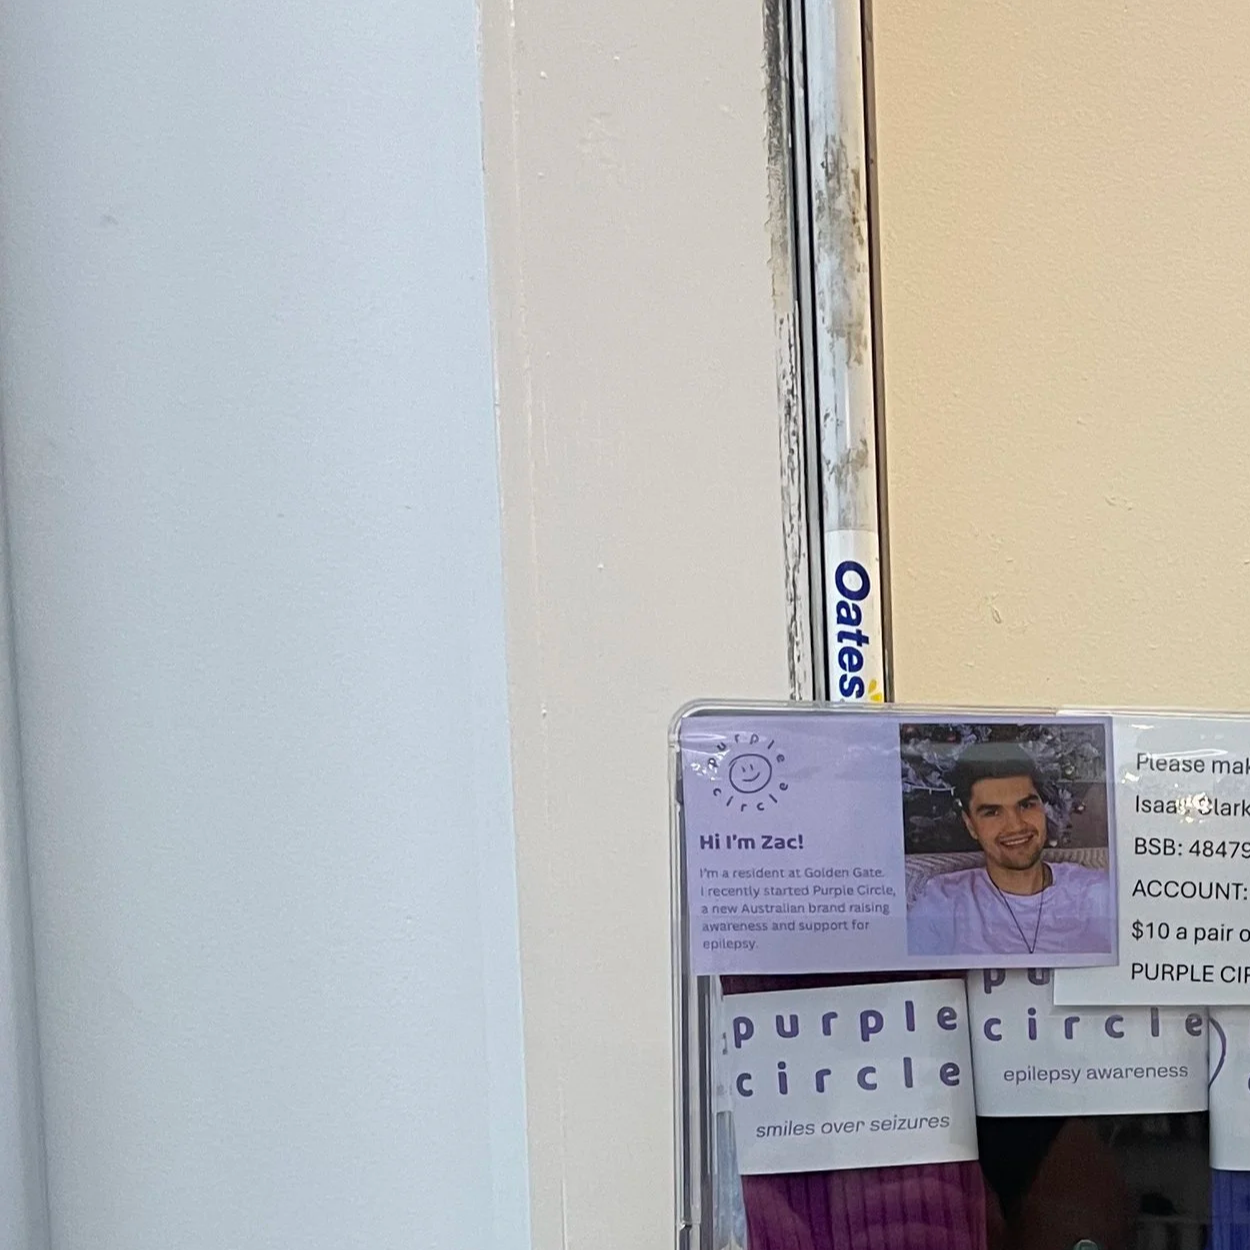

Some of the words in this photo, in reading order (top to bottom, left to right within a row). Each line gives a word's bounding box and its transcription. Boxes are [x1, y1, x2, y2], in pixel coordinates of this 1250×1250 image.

[835, 560, 871, 699] Oates
[707, 733, 785, 769] purple
[1136, 752, 1205, 773] Please
[712, 782, 789, 812] circle
[1135, 795, 1190, 816] Isaa
[700, 833, 720, 850] Hi
[726, 834, 756, 850] I'm
[761, 834, 804, 850] Zac!
[1134, 837, 1183, 857] BSB:
[700, 868, 719, 878] I'm
[732, 867, 785, 879] resident
[788, 869, 801, 878] at
[804, 867, 849, 879] Golden
[708, 885, 760, 898] recently
[763, 886, 809, 897] started
[812, 885, 854, 898] Purple
[857, 884, 896, 897] Circle,
[1131, 879, 1249, 901] ACCOUNT:
[701, 905, 709, 914] a
[712, 905, 738, 914] new
[741, 903, 805, 914] Australian
[808, 903, 846, 913] brand
[849, 902, 890, 915] raising
[702, 921, 768, 932] awareness
[771, 920, 796, 931] and
[799, 921, 848, 933] support
[851, 919, 870, 930] for
[1131, 919, 1170, 941] $10
[1175, 925, 1188, 940] a
[1194, 924, 1234, 945] pair
[703, 938, 759, 951] epilepsy.
[1131, 962, 1215, 983] PURPLE
[733, 1000, 958, 1049] purple
[983, 1007, 1203, 1042] circle
[735, 1056, 961, 1098] circle
[1003, 1066, 1081, 1085] epilepsy
[1086, 1064, 1189, 1081] awareness
[755, 1119, 816, 1138] smiles
[820, 1118, 865, 1135] over
[869, 1114, 951, 1132] seizures
